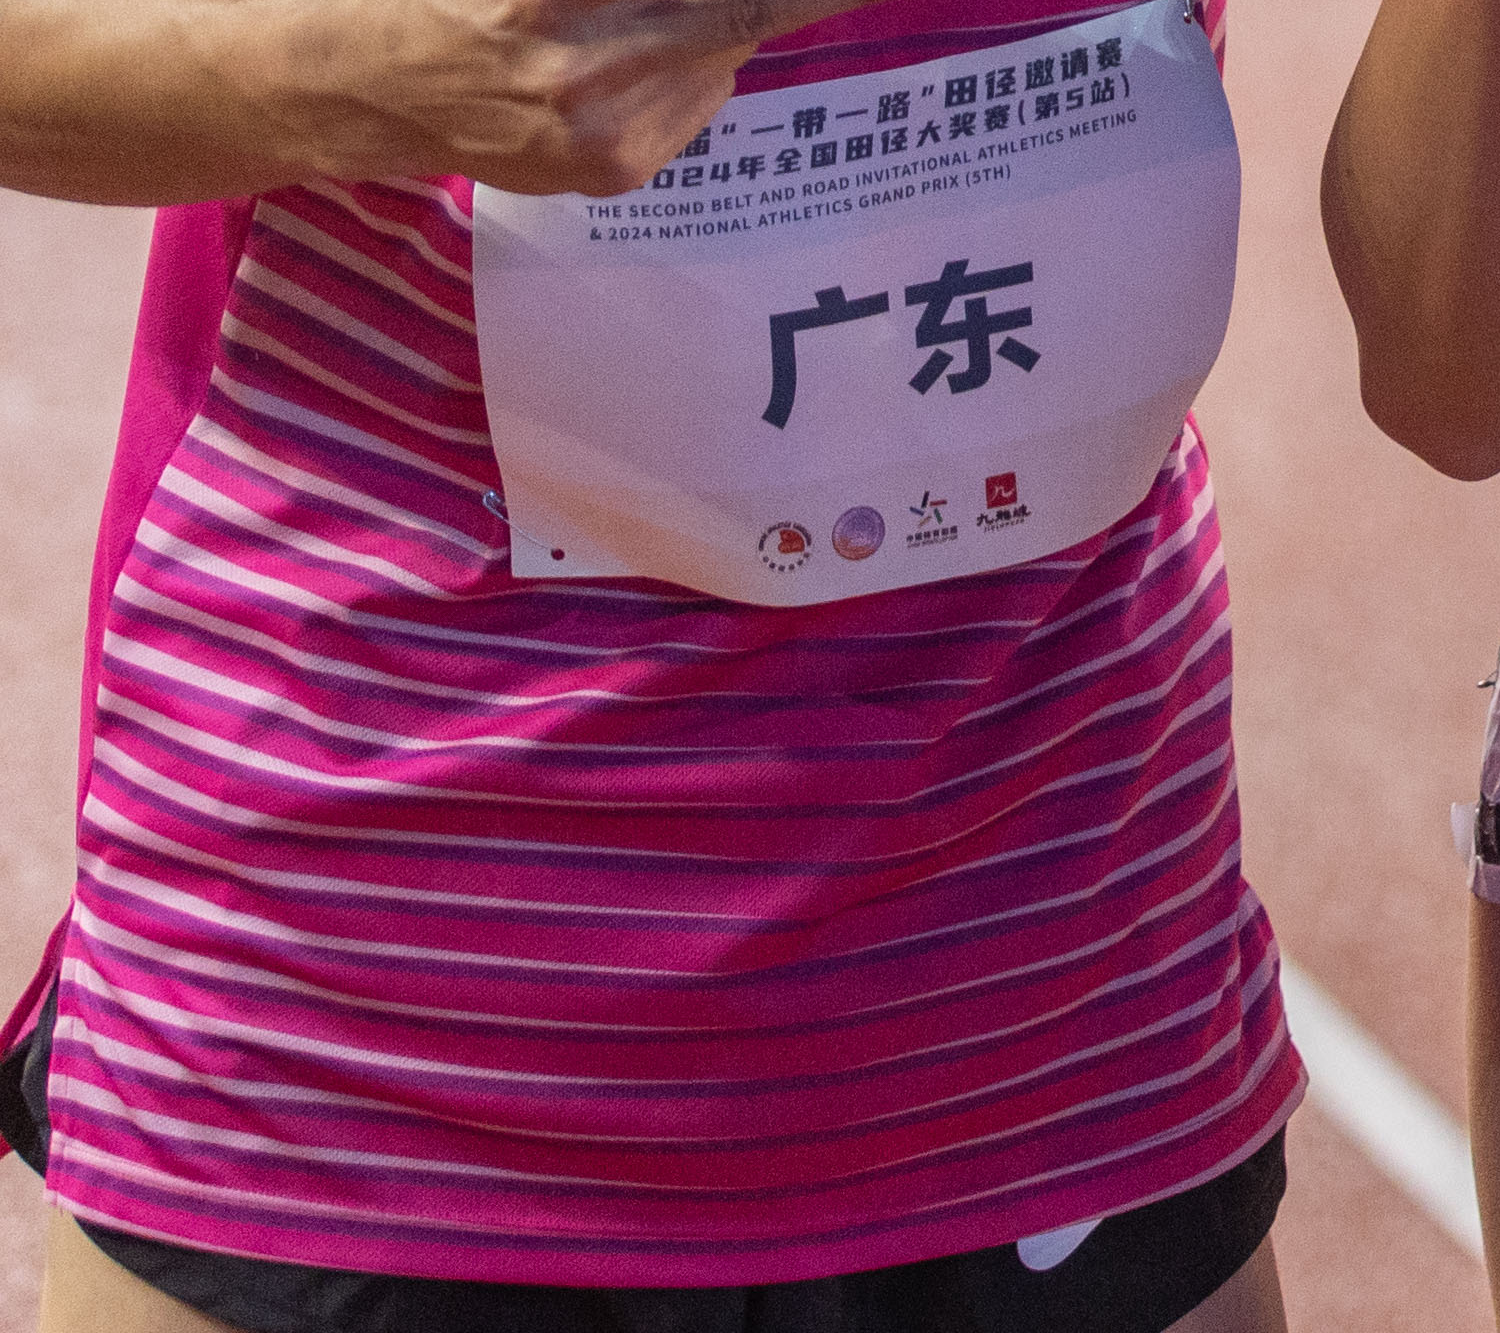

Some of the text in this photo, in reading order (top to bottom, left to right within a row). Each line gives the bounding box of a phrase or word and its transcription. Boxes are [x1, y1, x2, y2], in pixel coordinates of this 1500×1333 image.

[586, 109, 1137, 219] THE SECOND BELT AND ROAD INVITATIONAL ATHLETICS MEETING
[641, 73, 1130, 189] 024年全国田径大奖赛(第5站)
[590, 165, 1011, 241] & 2024 NATIONAL ATHLETICS GRAND PRIX (5TH)
[761, 258, 1042, 430] 广东
